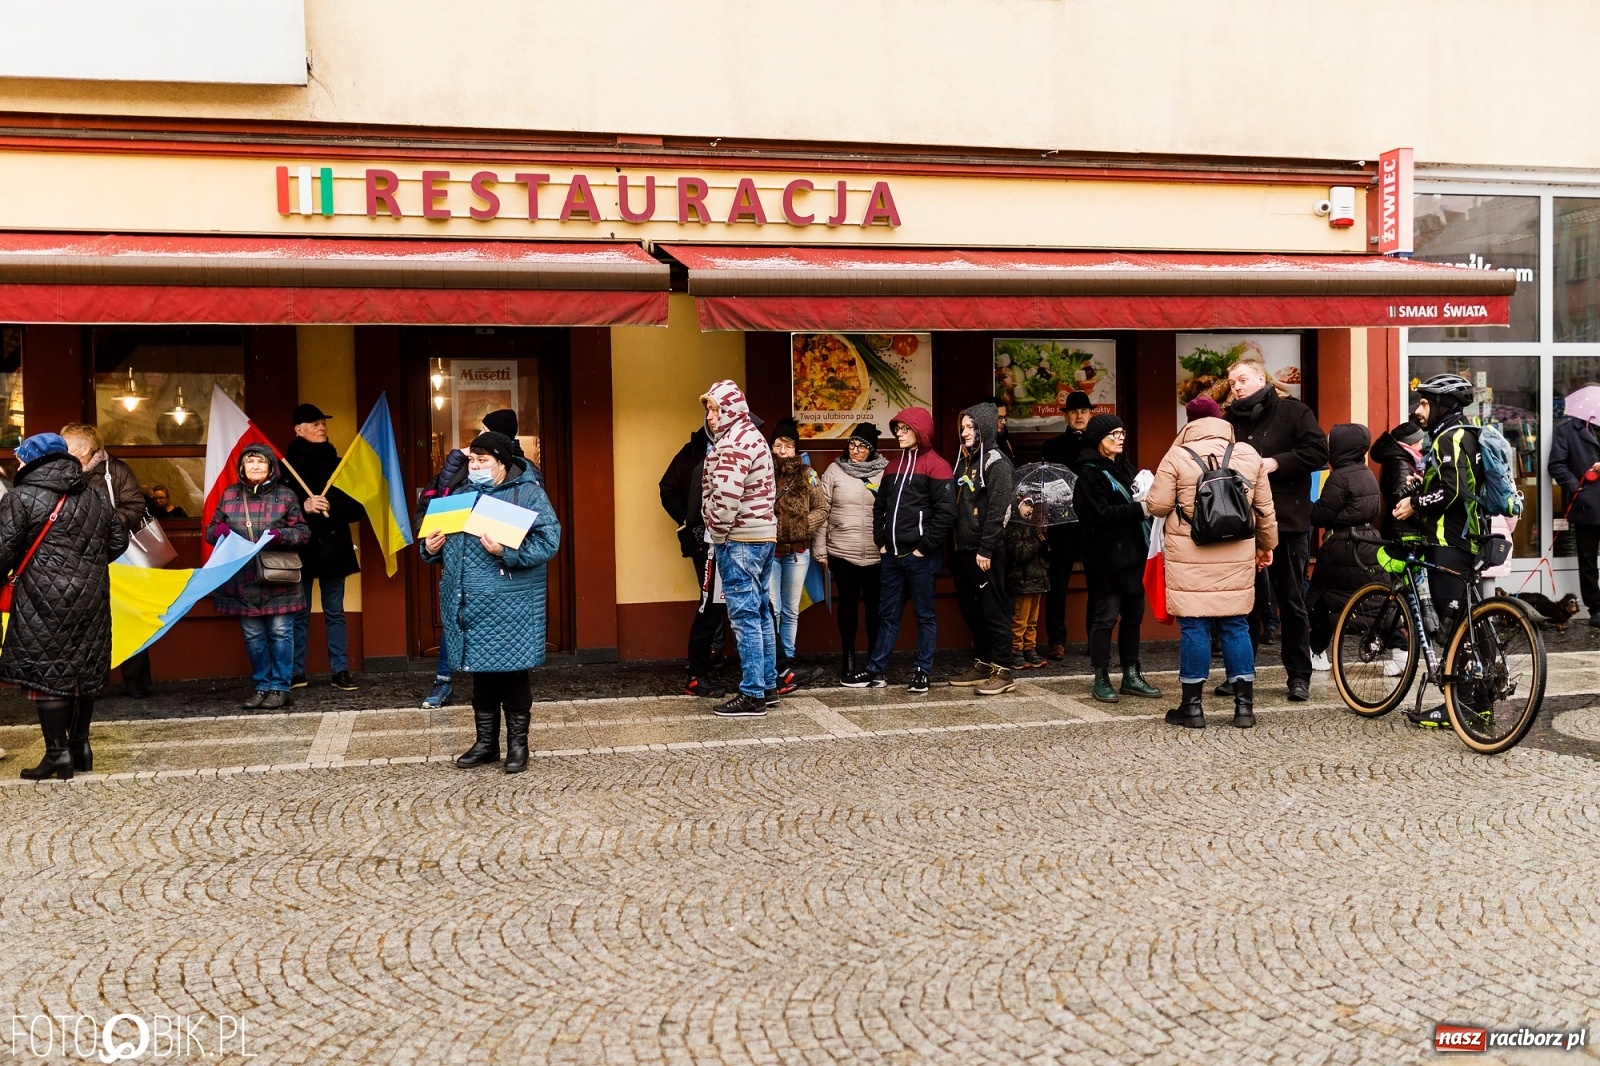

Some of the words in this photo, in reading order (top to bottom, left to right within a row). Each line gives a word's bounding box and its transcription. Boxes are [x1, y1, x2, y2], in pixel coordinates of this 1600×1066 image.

[365, 168, 902, 229] RESTAURACJA
[1382, 158, 1397, 243] ŻYWIEC
[1398, 305, 1438, 318] SMAKI
[1443, 303, 1488, 318] ŚWIATA
[459, 366, 512, 381] Musetti
[799, 413, 821, 421] Twoja
[822, 412, 855, 420] ulubiona
[856, 412, 874, 421] pizza
[1037, 405, 1055, 414] Tylko
